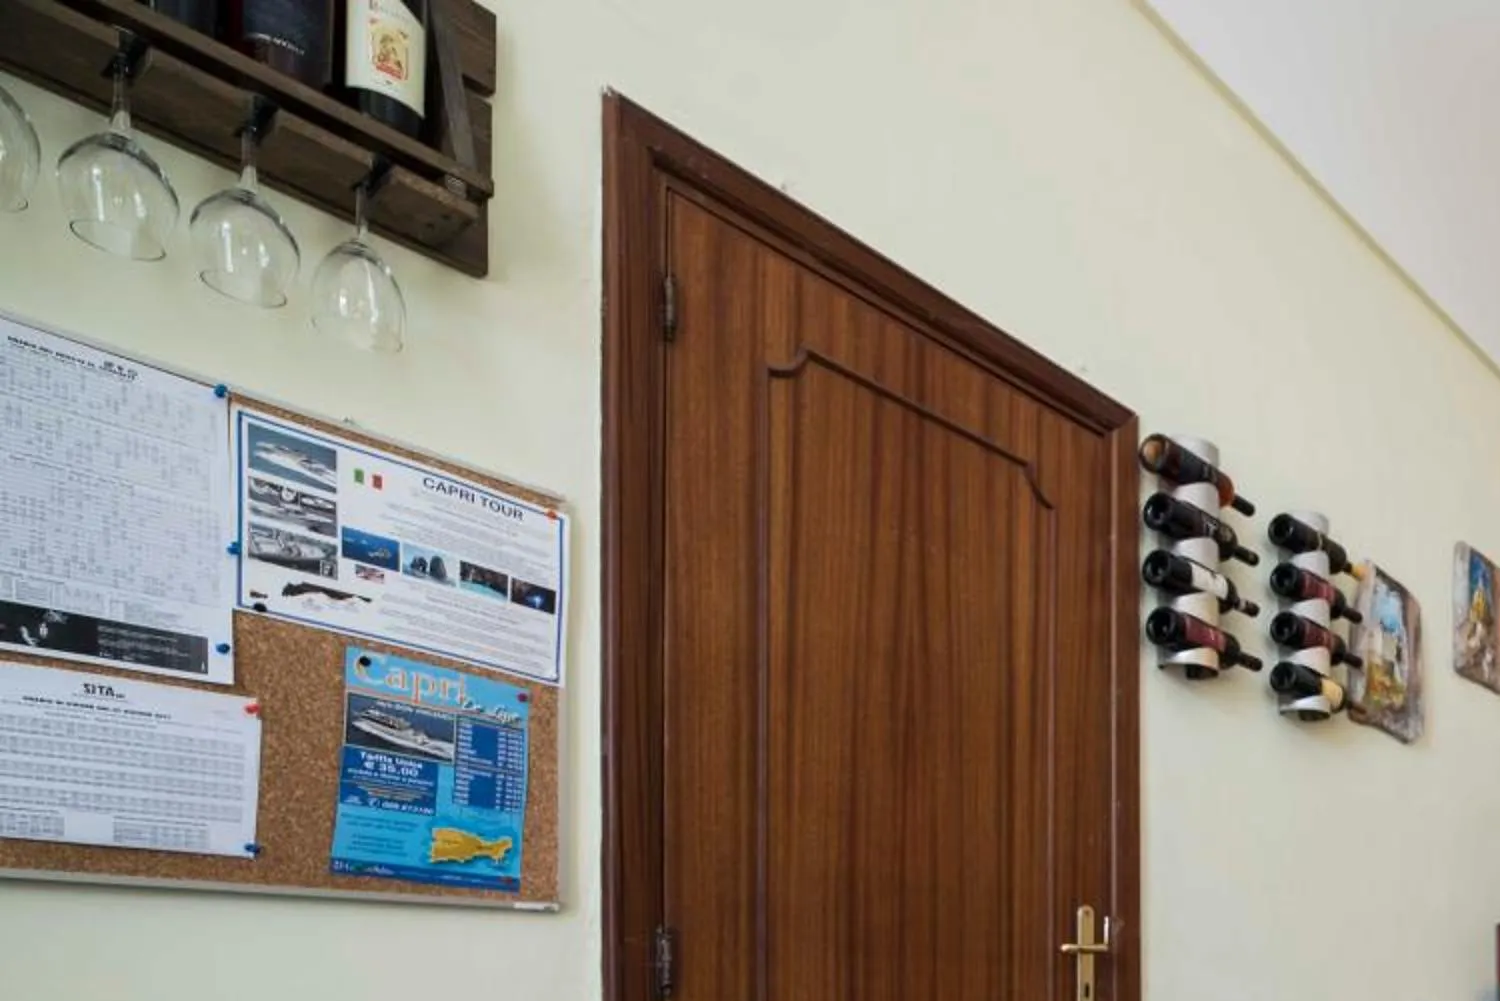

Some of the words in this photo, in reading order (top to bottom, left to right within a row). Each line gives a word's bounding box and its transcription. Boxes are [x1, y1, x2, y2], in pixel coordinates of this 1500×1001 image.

[423, 477, 476, 503] CAPRI
[480, 496, 524, 521] TOUR
[83, 682, 115, 697] SITA
[354, 651, 467, 705] Capri
